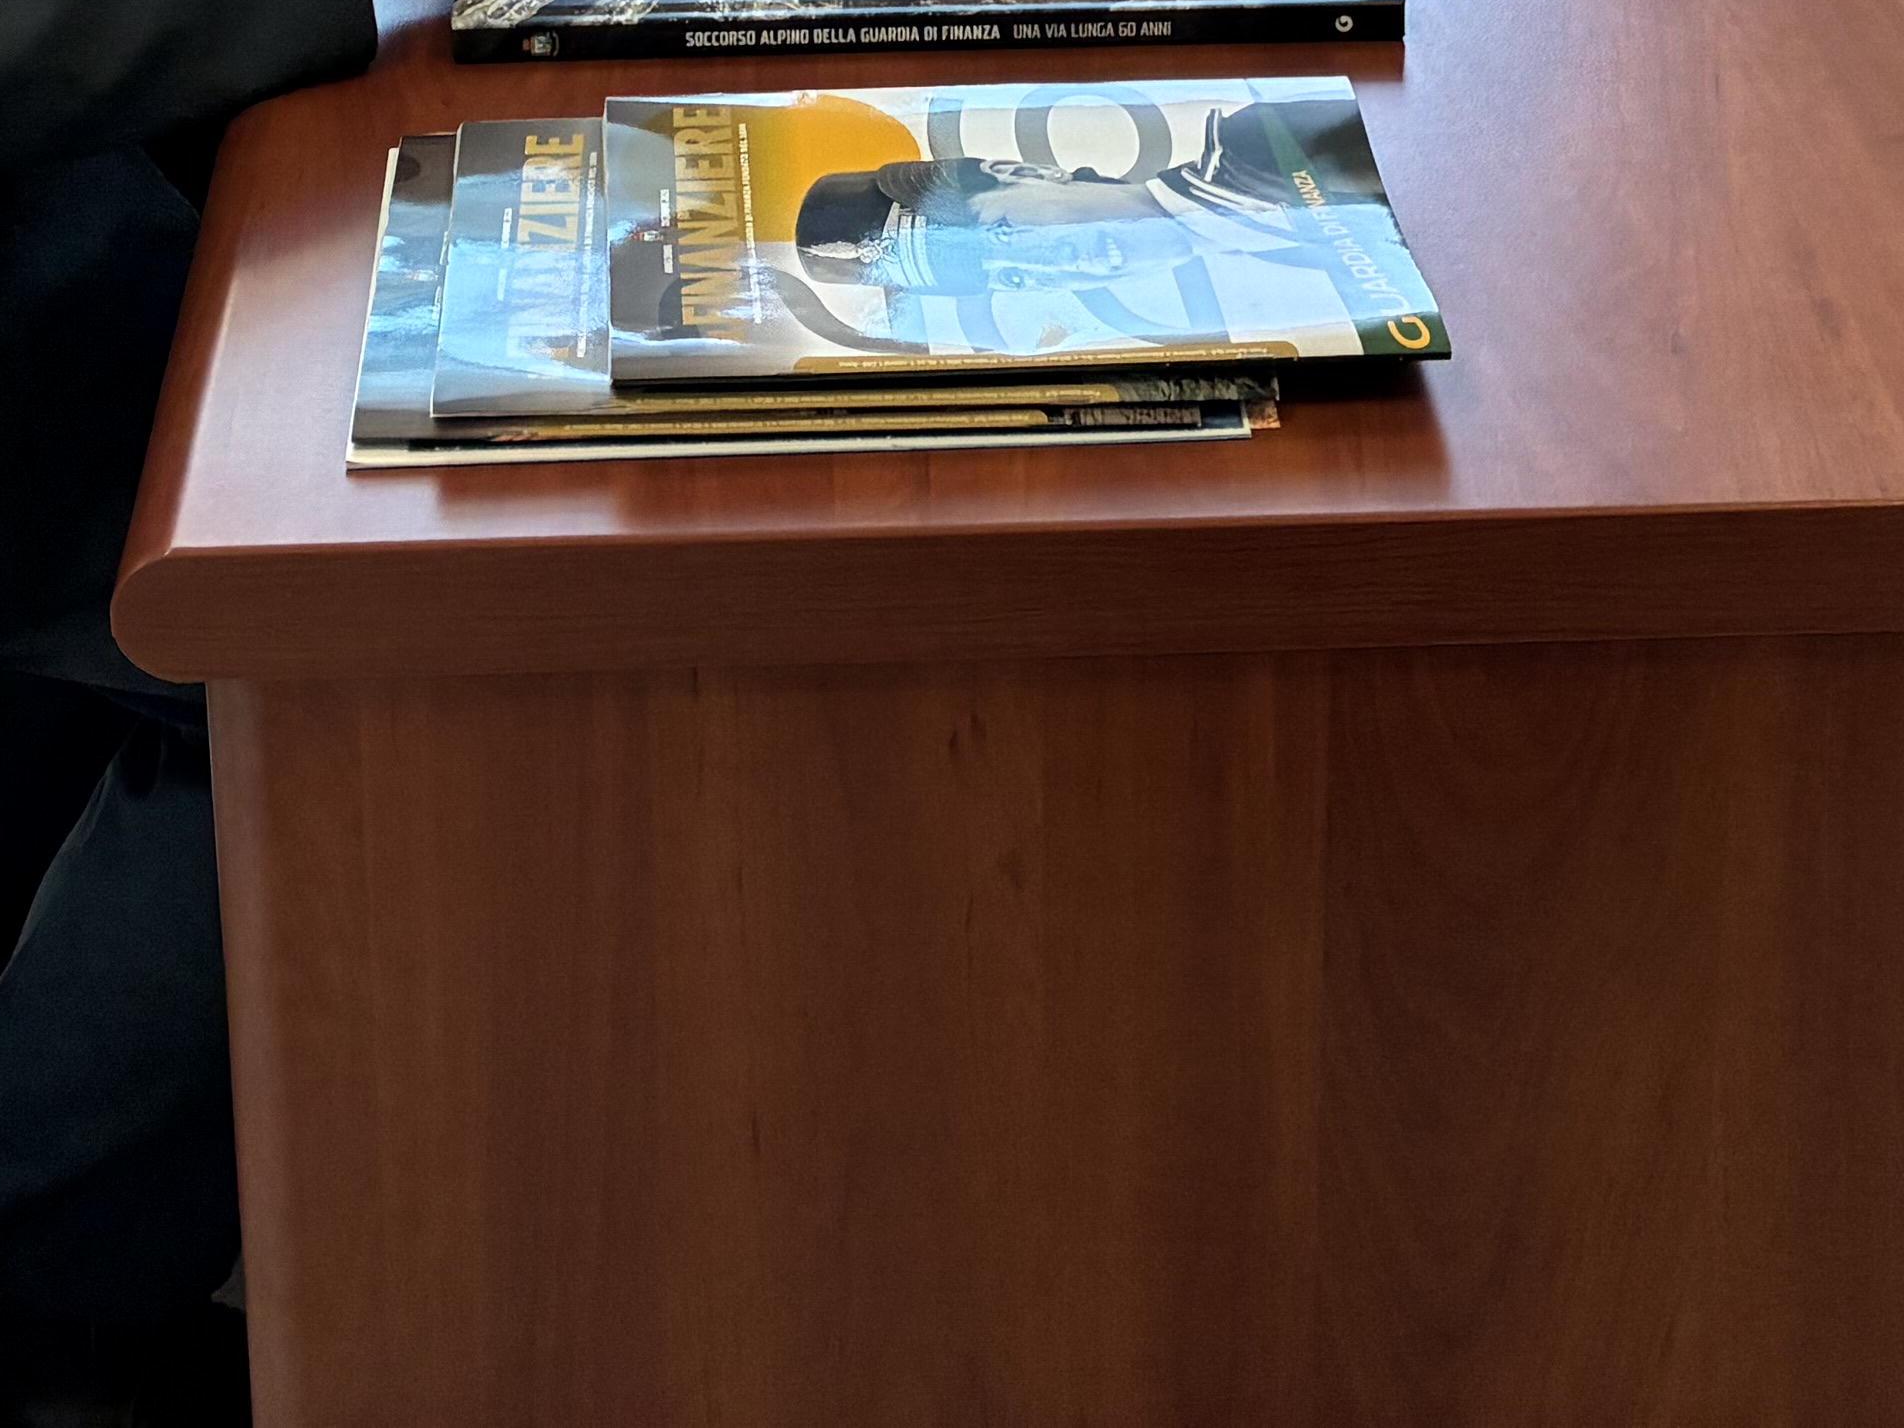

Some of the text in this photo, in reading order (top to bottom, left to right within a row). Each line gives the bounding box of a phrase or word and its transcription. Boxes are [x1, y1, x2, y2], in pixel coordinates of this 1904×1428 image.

[685, 21, 1172, 47] SOCCORSO ALPINO DELLA GUARDIA DI FINANZA UNA VIA LUNGA 60 ANNI
[673, 106, 741, 325] FINANZIERE
[1334, 237, 1431, 350] GUARDIA
